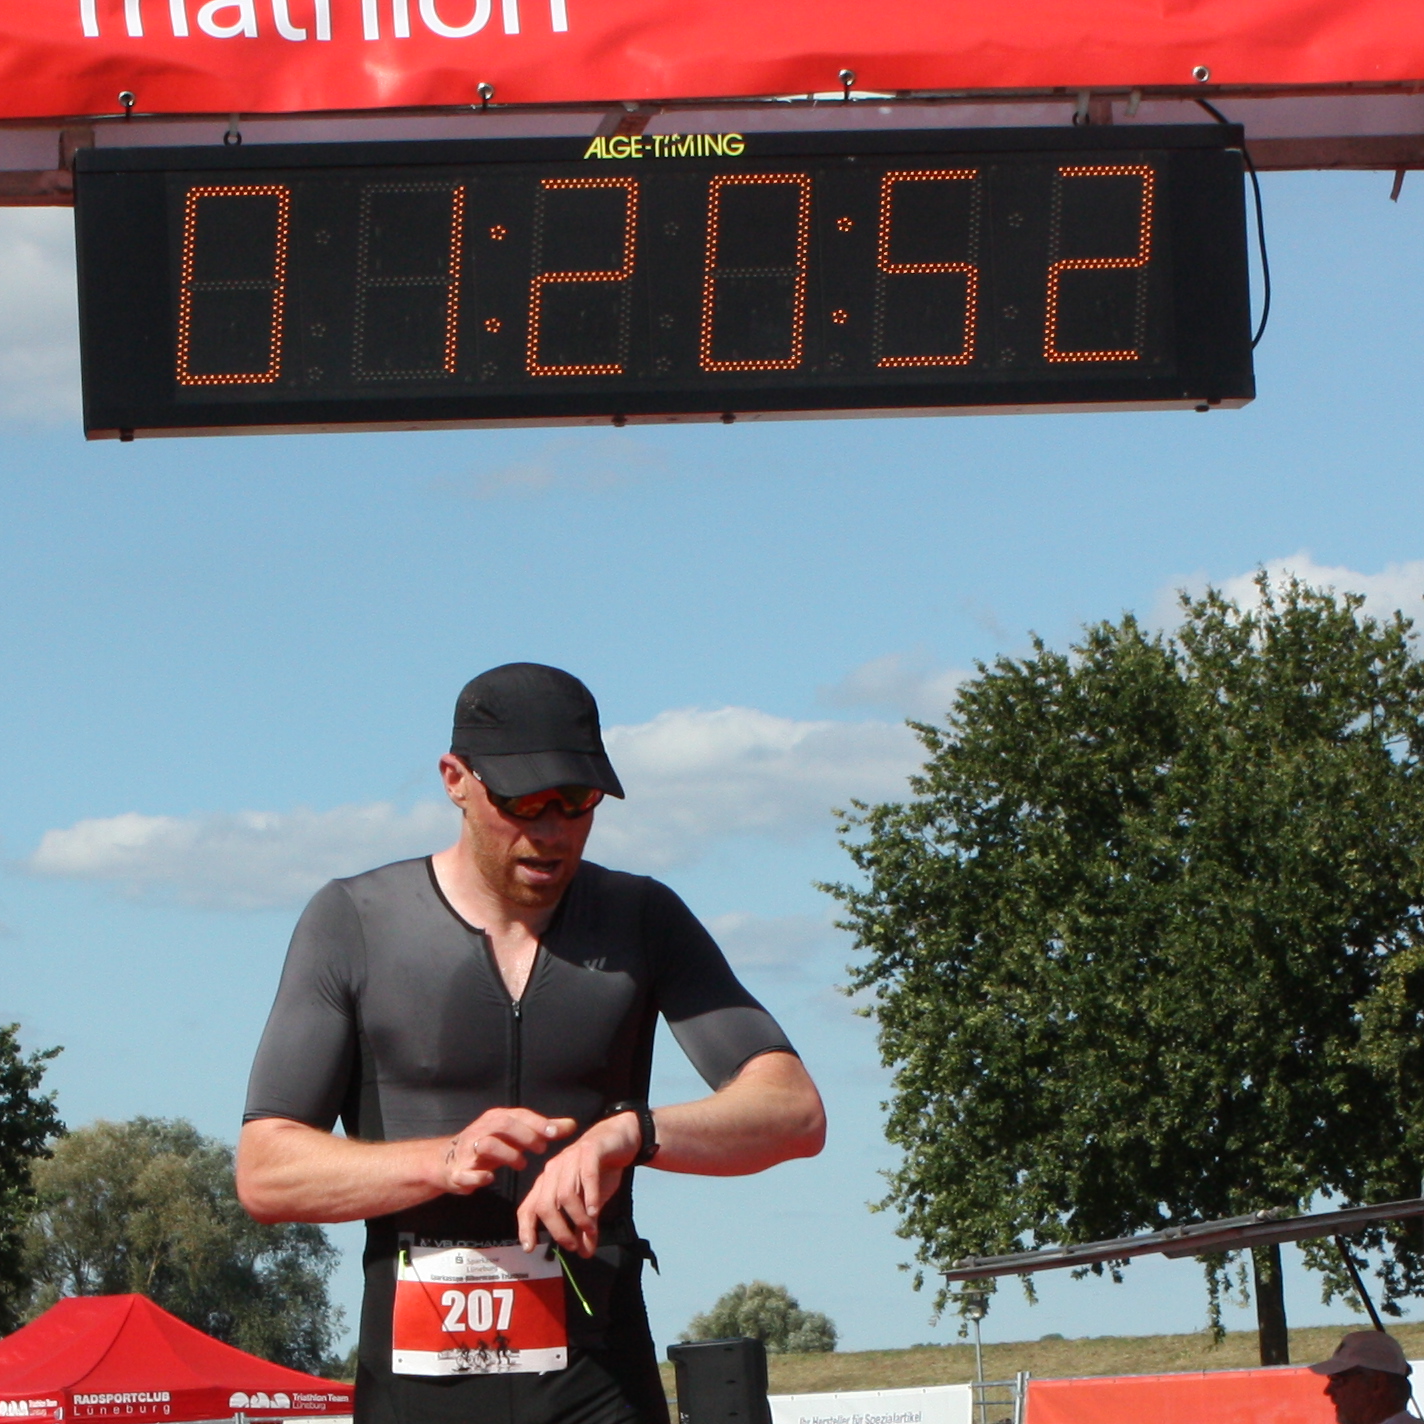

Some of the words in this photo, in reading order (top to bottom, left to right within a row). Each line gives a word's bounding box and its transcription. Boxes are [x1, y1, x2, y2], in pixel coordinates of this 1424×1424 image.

[583, 132, 746, 160] ALGE-TIMING
[441, 1288, 515, 1332] 207
[73, 1391, 171, 1405] RADSPORTCLUB
[73, 1405, 171, 1417] Lüneburg
